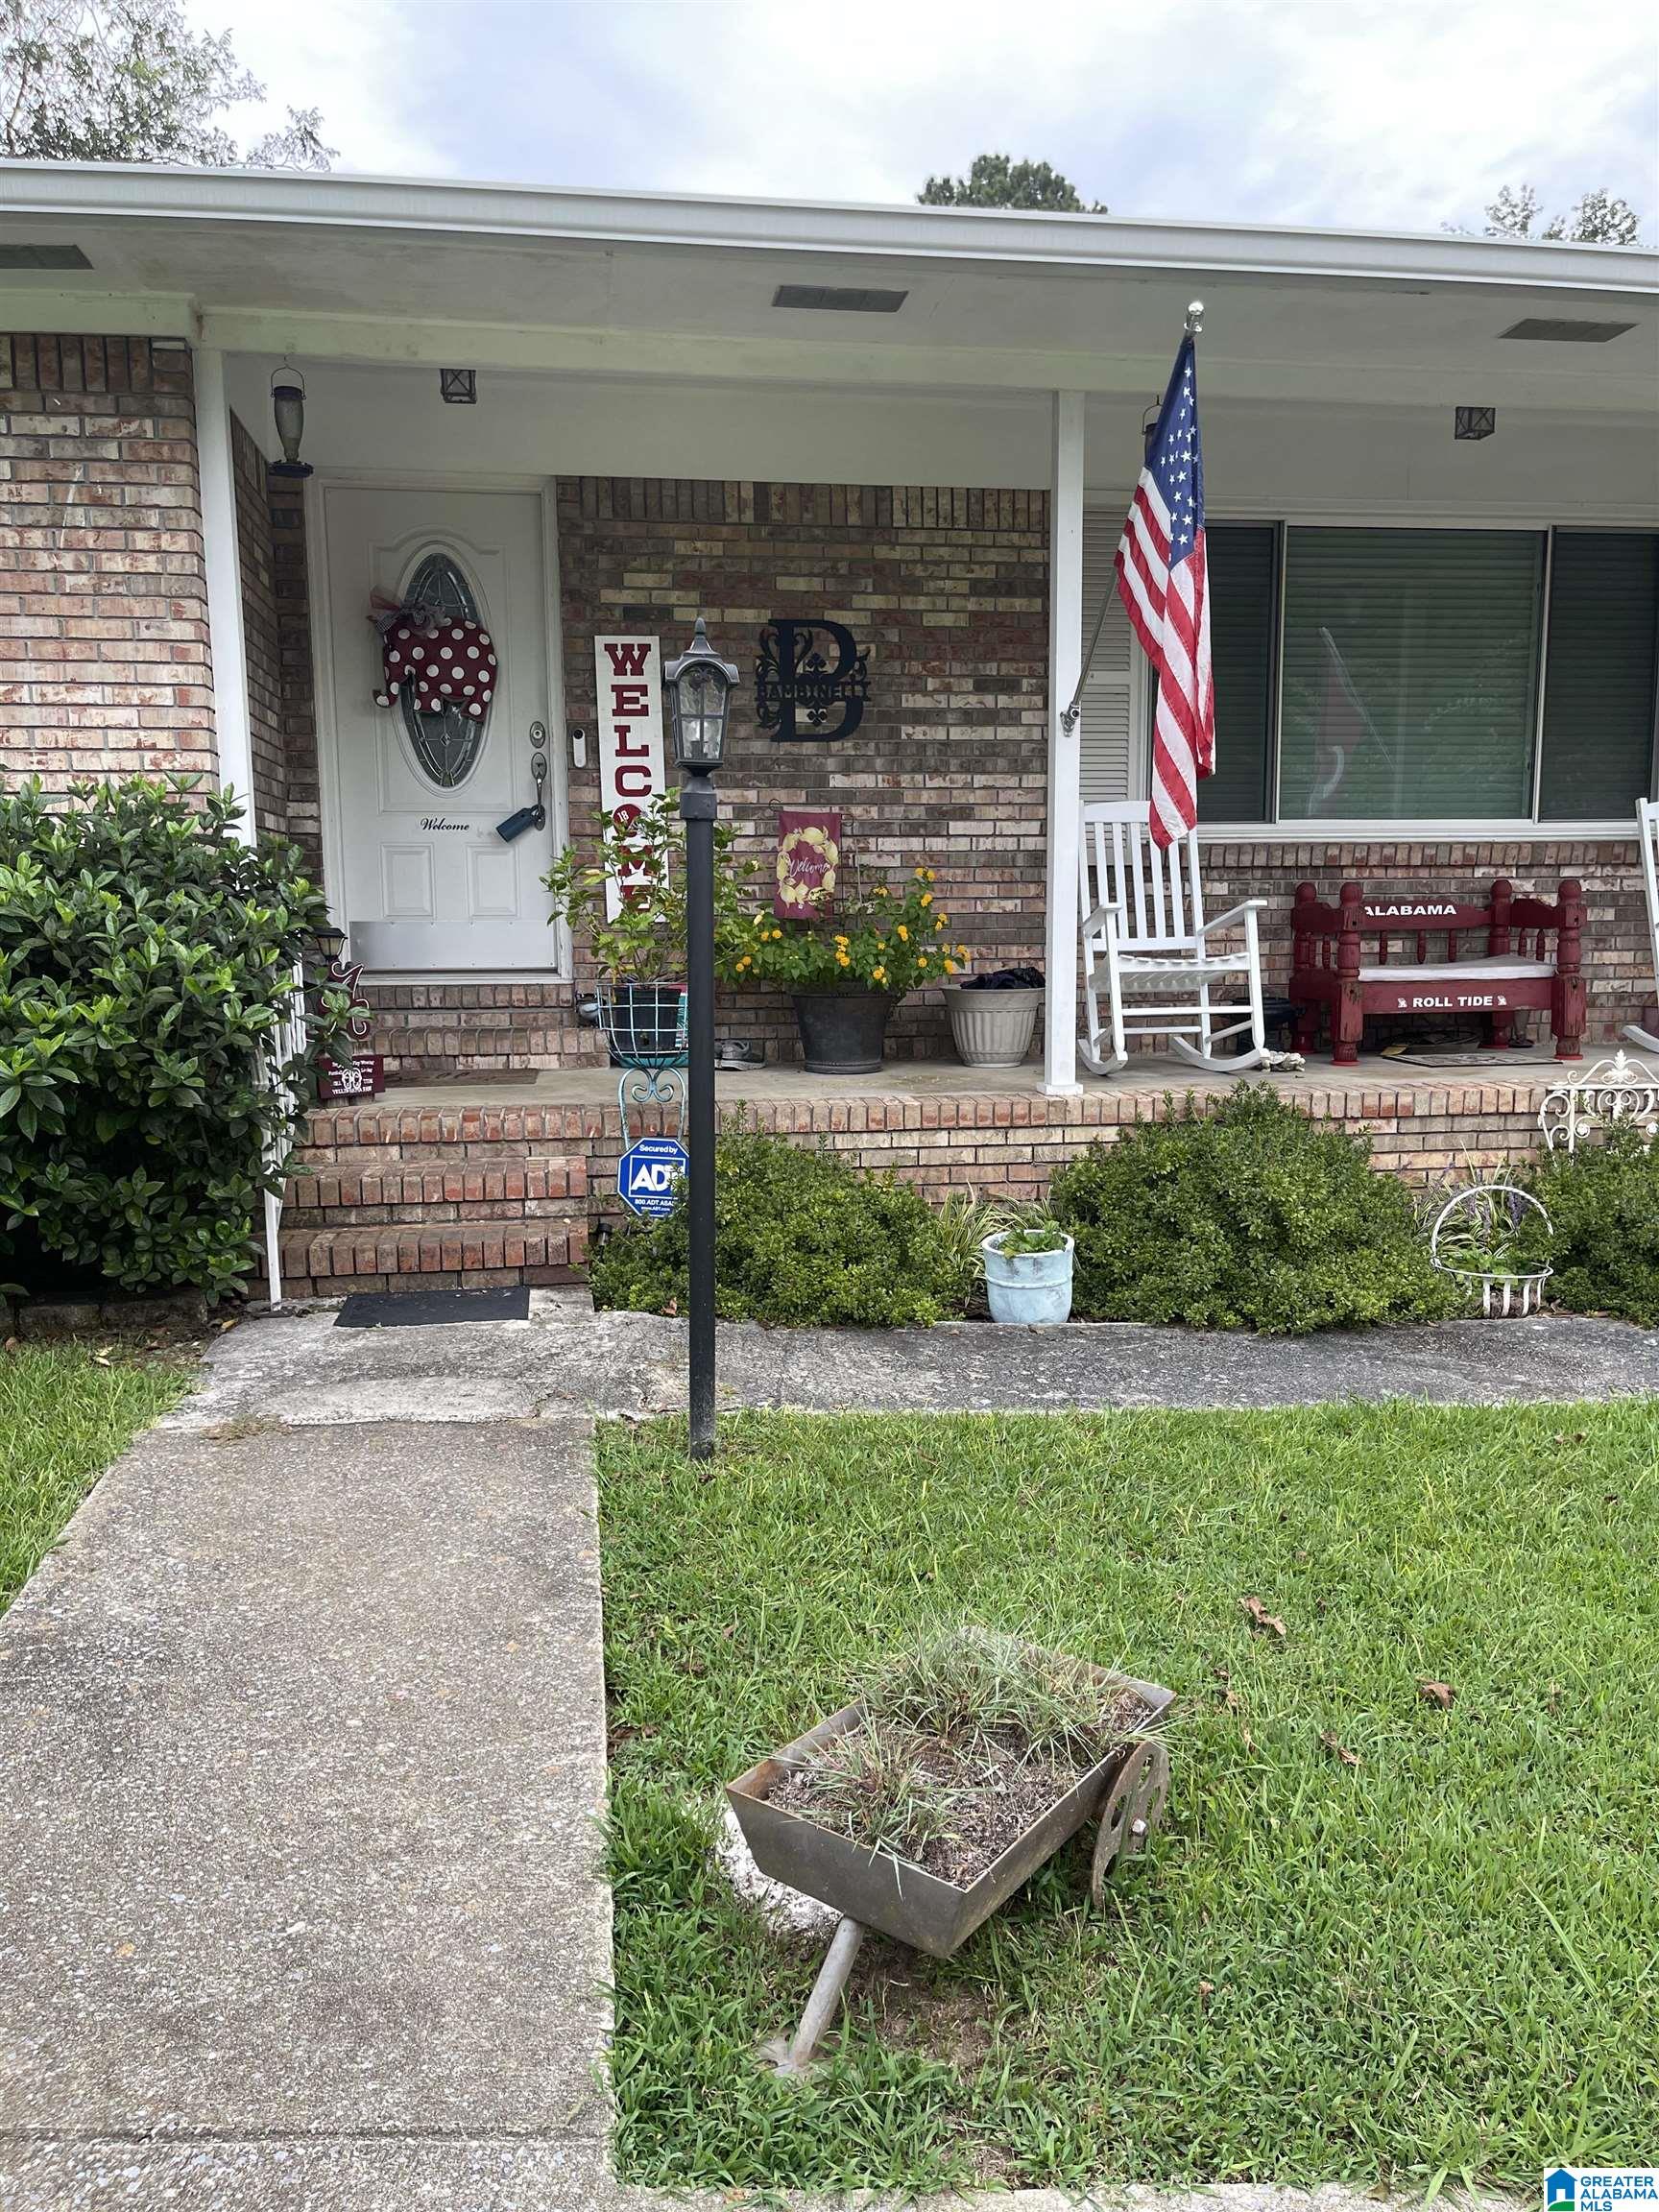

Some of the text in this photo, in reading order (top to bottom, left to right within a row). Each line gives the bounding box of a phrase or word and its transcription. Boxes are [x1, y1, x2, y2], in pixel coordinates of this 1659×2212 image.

[616, 809, 630, 823] 18
[420, 817, 470, 831] Welcome
[788, 856, 831, 878] Welcome
[1364, 904, 1457, 916] ALABAMA
[1412, 996, 1493, 1007] ROLL TIDE
[639, 1143, 678, 1155] Secured by
[635, 1198, 674, 1207] 800.ADT.ASA
